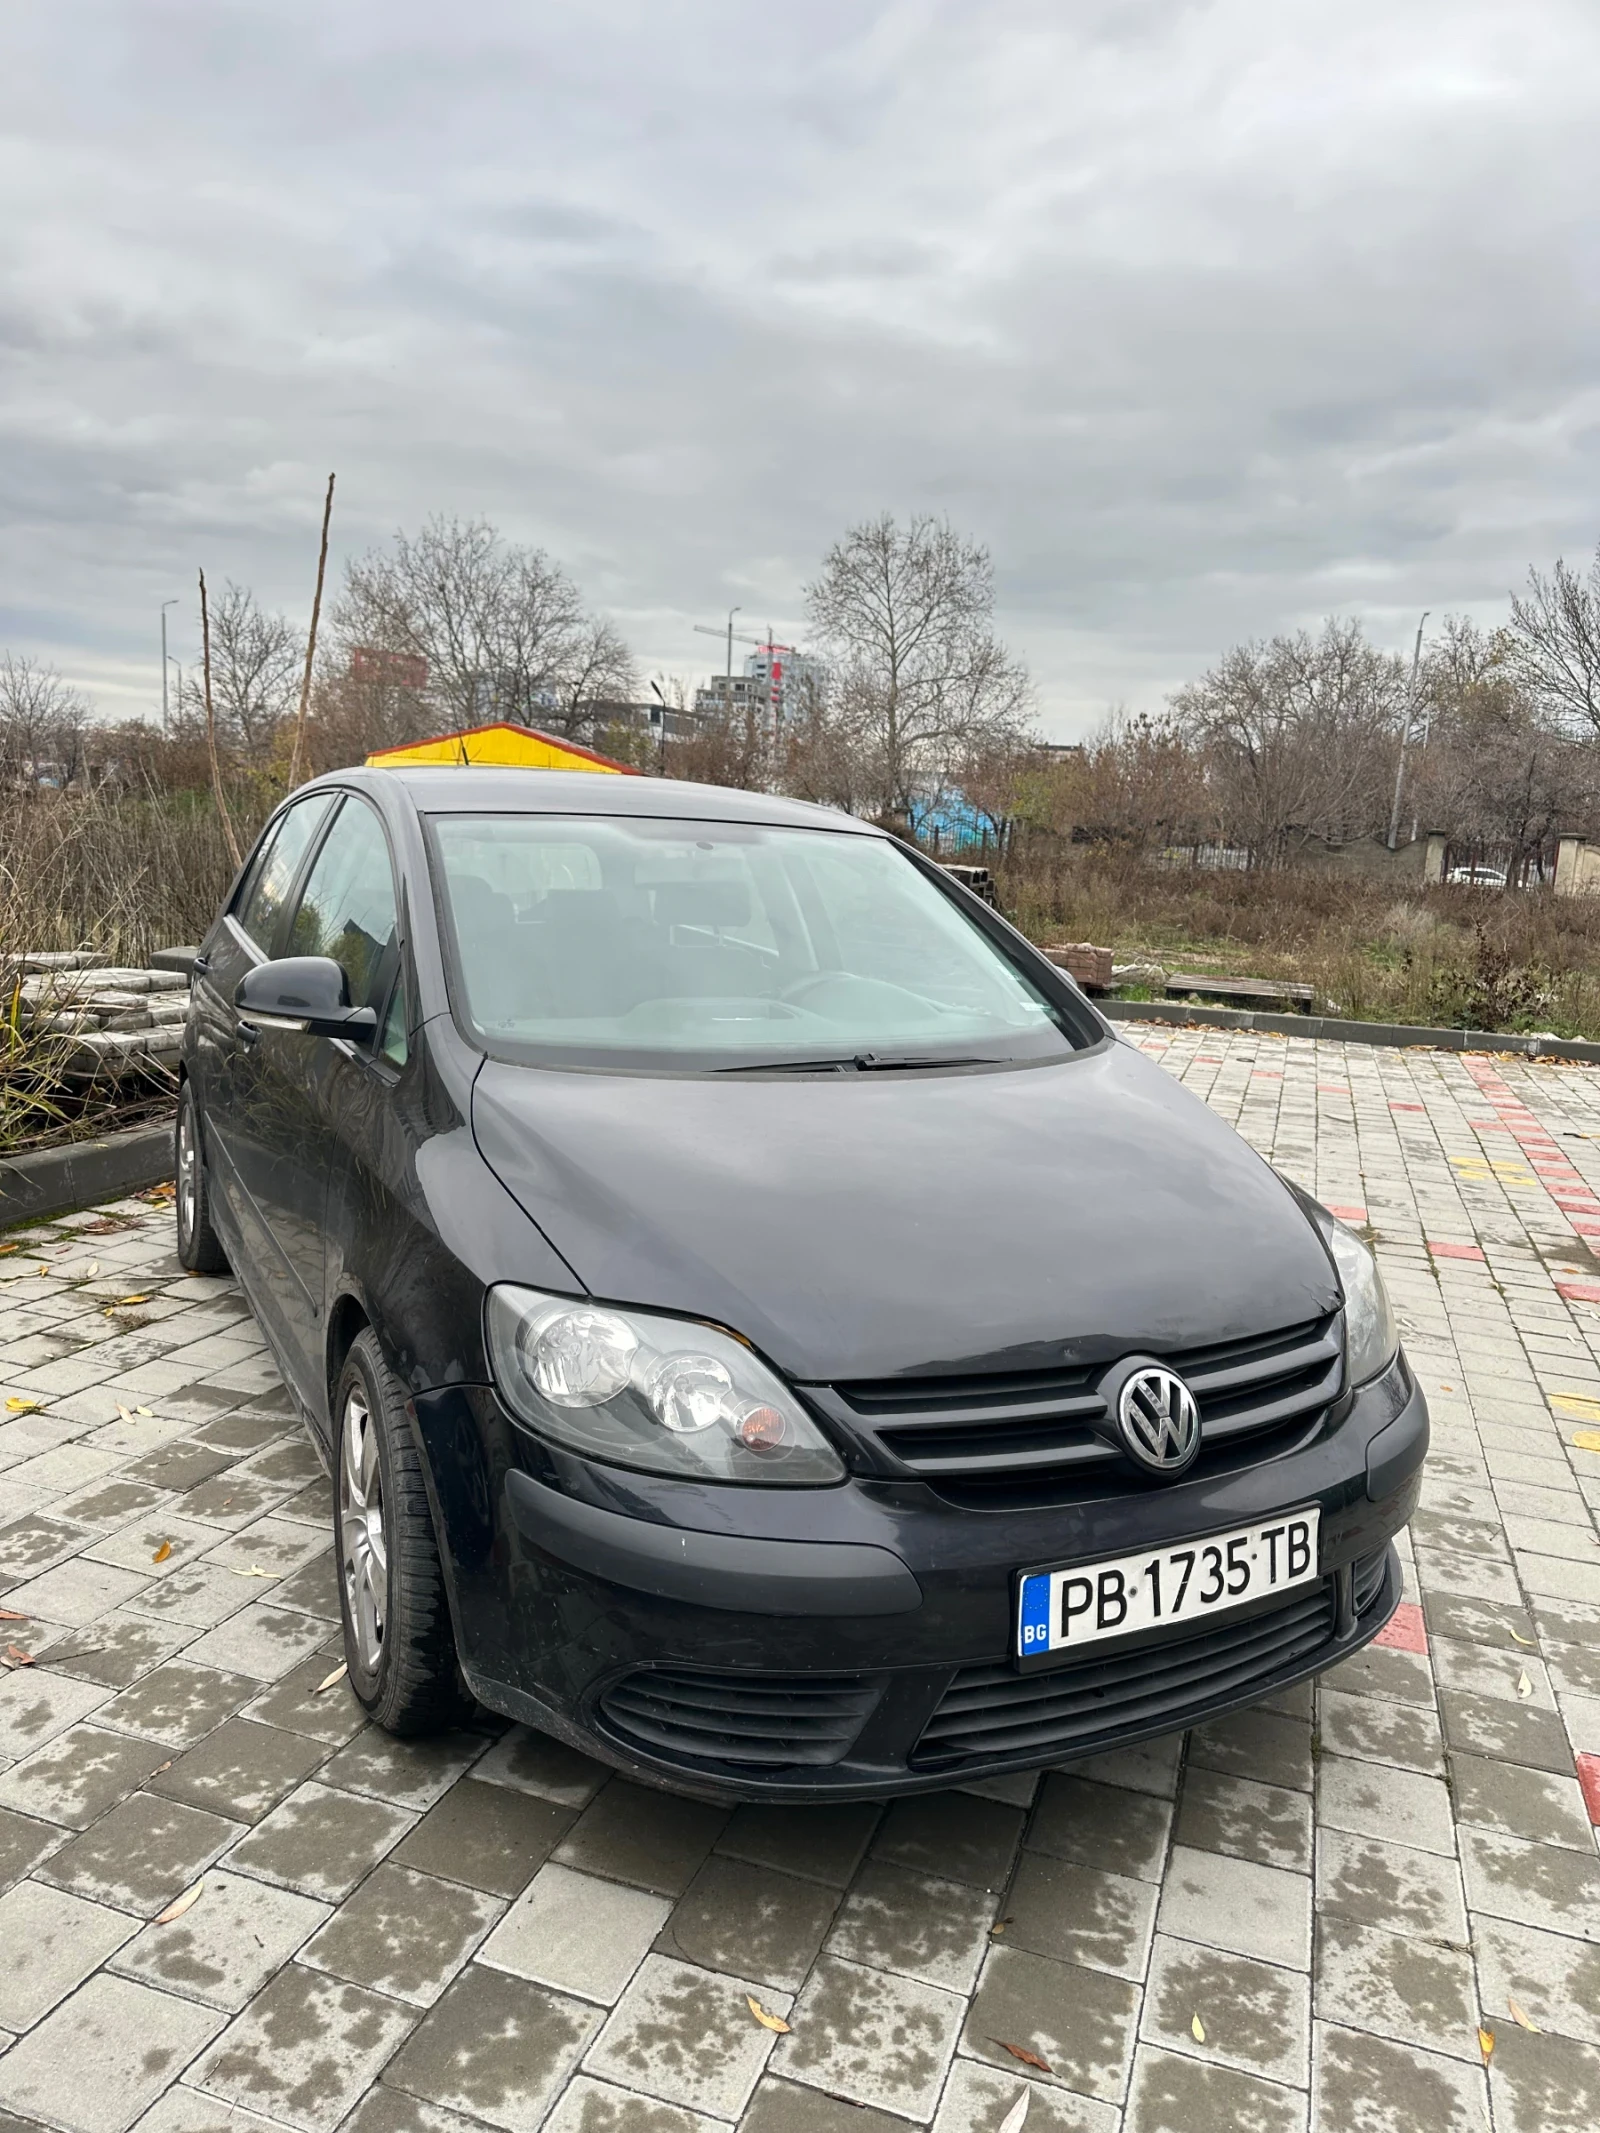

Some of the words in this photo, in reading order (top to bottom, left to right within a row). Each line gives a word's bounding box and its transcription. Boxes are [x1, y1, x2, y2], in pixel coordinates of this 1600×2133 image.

[1120, 1368, 1198, 1468] VW
[1060, 1569, 1128, 1638] PB
[1144, 1536, 1251, 1617] 1735
[1260, 1520, 1311, 1584] TB
[1024, 1623, 1047, 1644] BG
